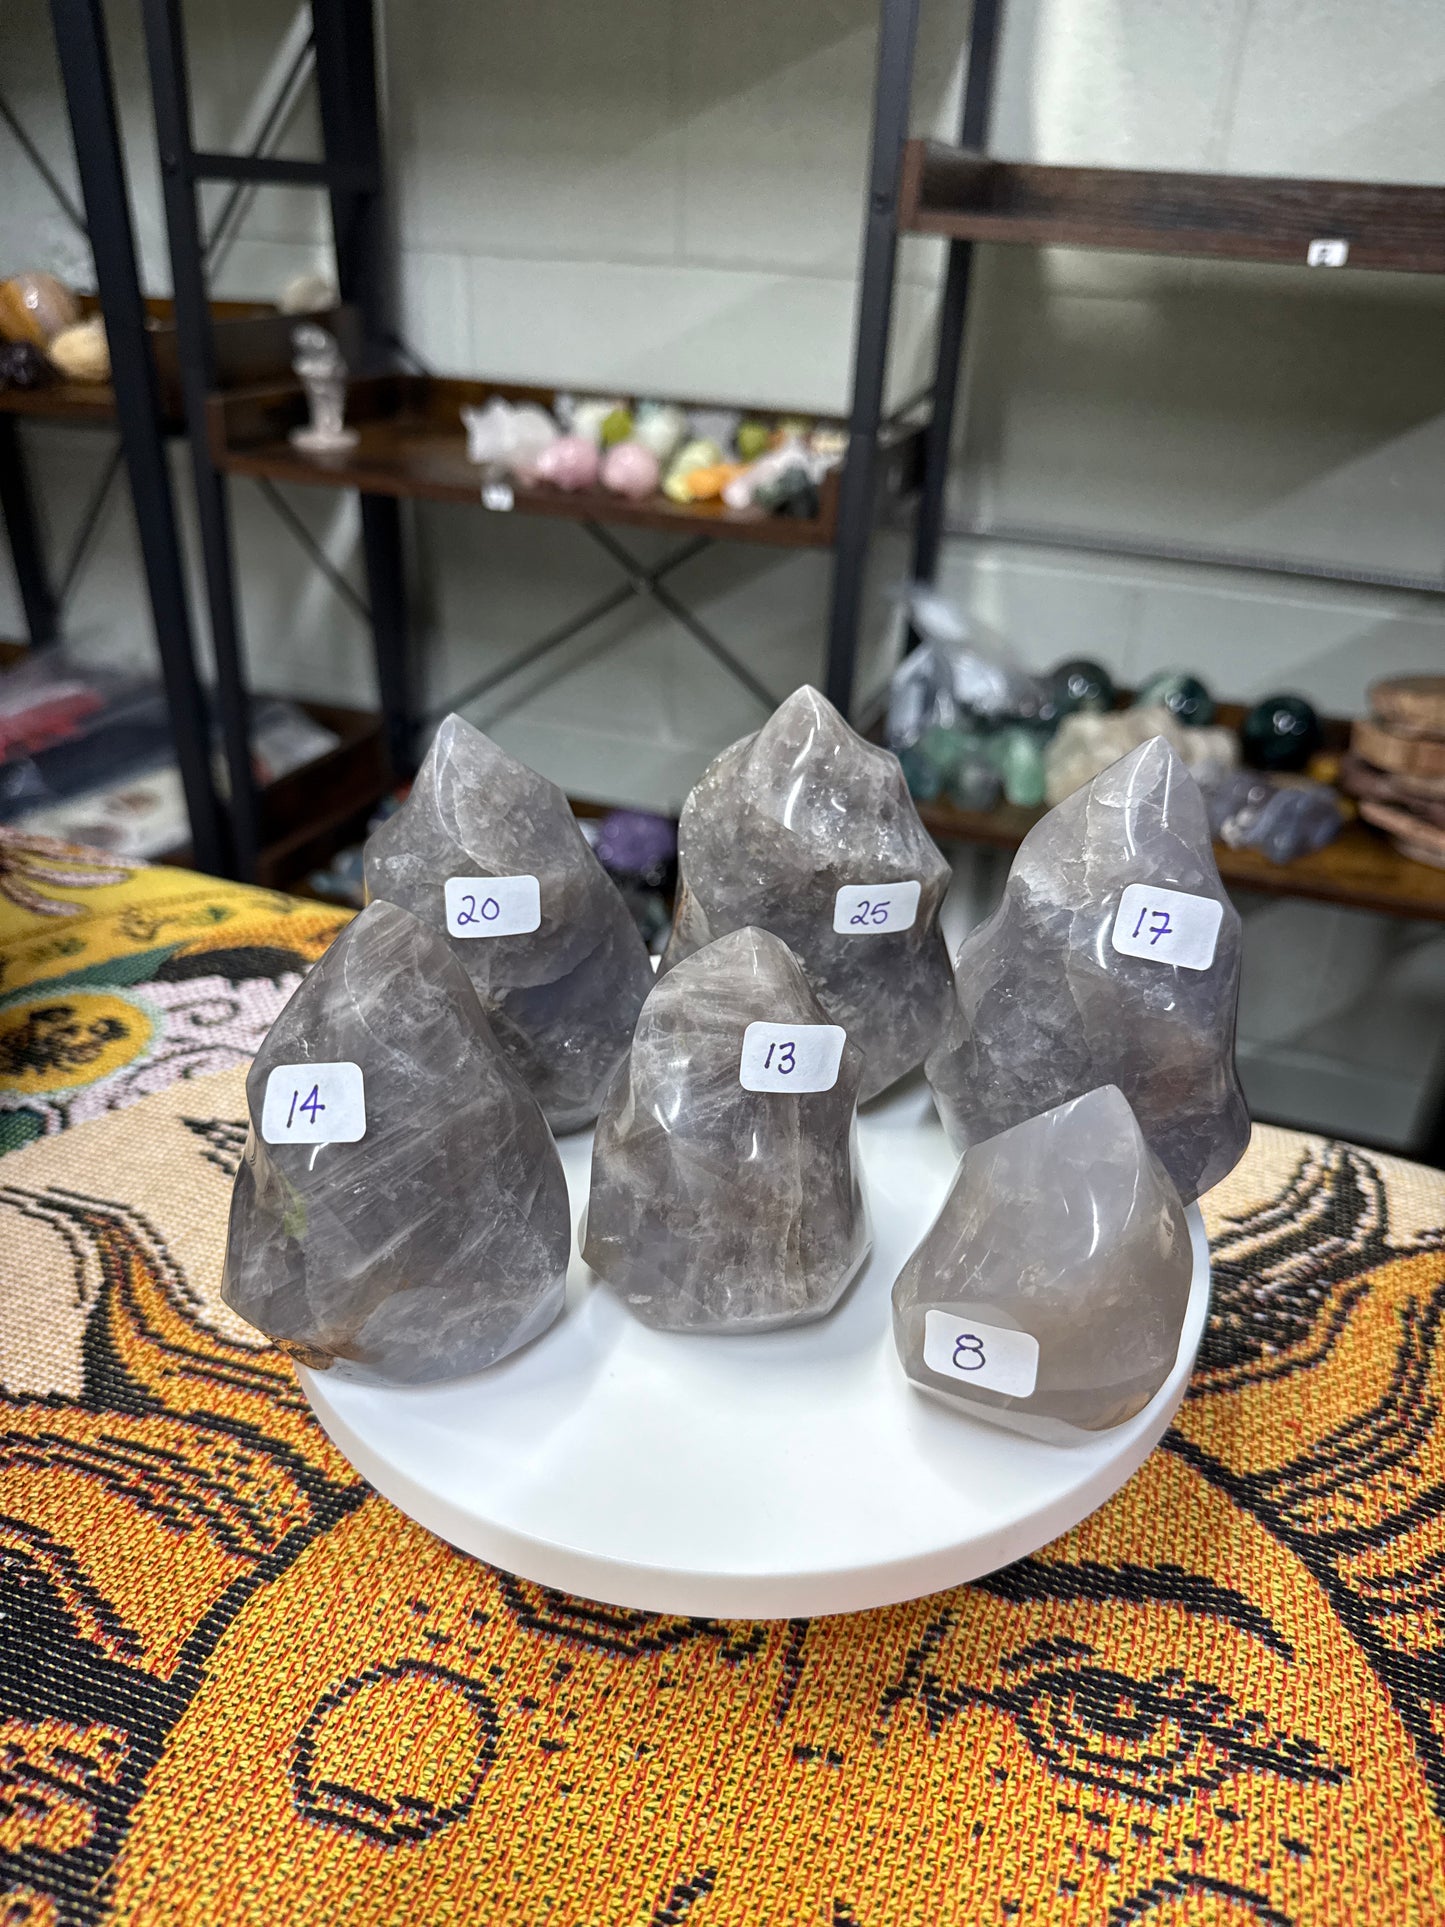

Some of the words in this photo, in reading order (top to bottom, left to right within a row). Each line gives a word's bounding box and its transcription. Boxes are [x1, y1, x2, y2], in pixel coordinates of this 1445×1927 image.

[457, 894, 500, 926] 20
[849, 900, 891, 926] 25
[1132, 906, 1173, 945] 17
[764, 1041, 796, 1075] 13
[286, 1083, 326, 1129] 14
[952, 1333, 986, 1371] 8
